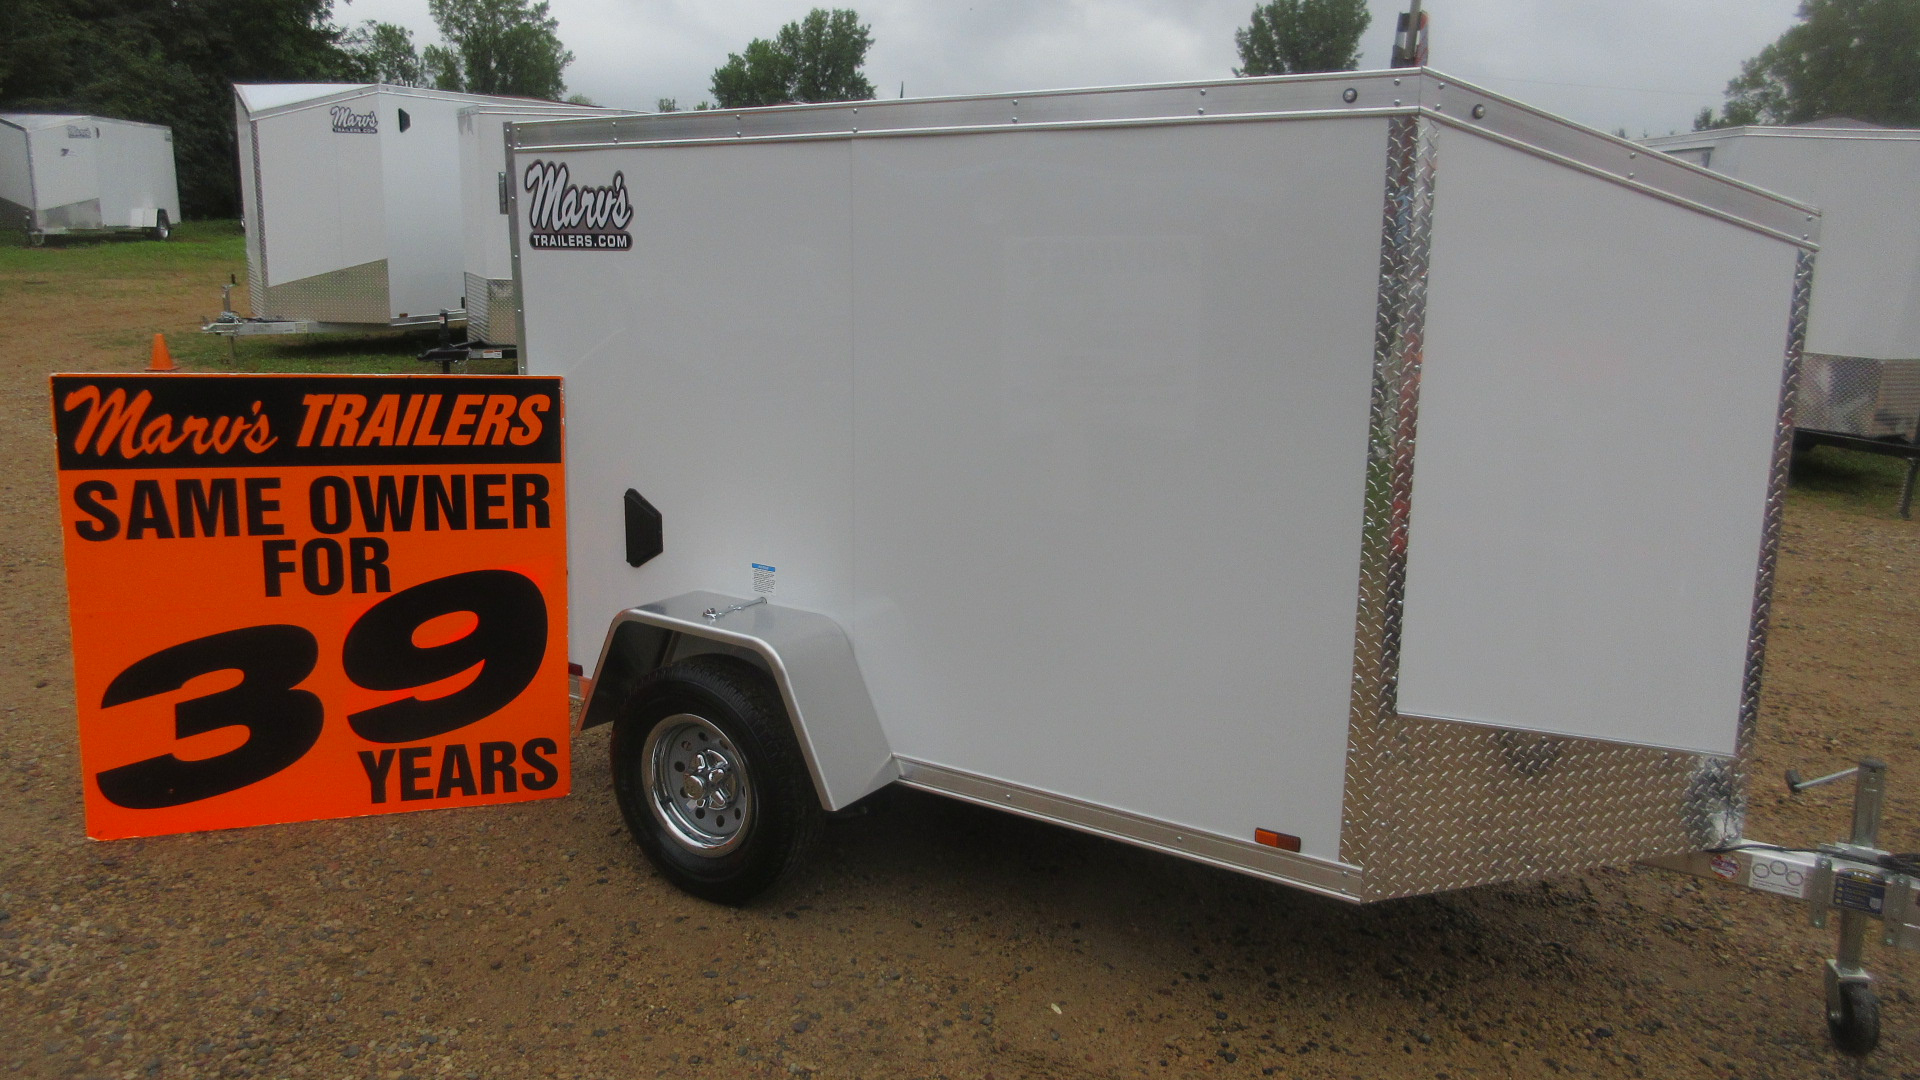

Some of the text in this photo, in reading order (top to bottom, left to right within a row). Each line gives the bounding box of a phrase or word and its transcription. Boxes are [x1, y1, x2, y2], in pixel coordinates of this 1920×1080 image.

[330, 106, 378, 128] Marv's
[525, 160, 633, 232] Marv's
[533, 234, 628, 248] TRAILERS.COM
[63, 384, 552, 460] Marv's TRAILERS
[73, 473, 551, 542] SAME OWNER
[262, 537, 391, 598] FOR
[96, 568, 549, 809] 39
[358, 737, 559, 804] YEARS
